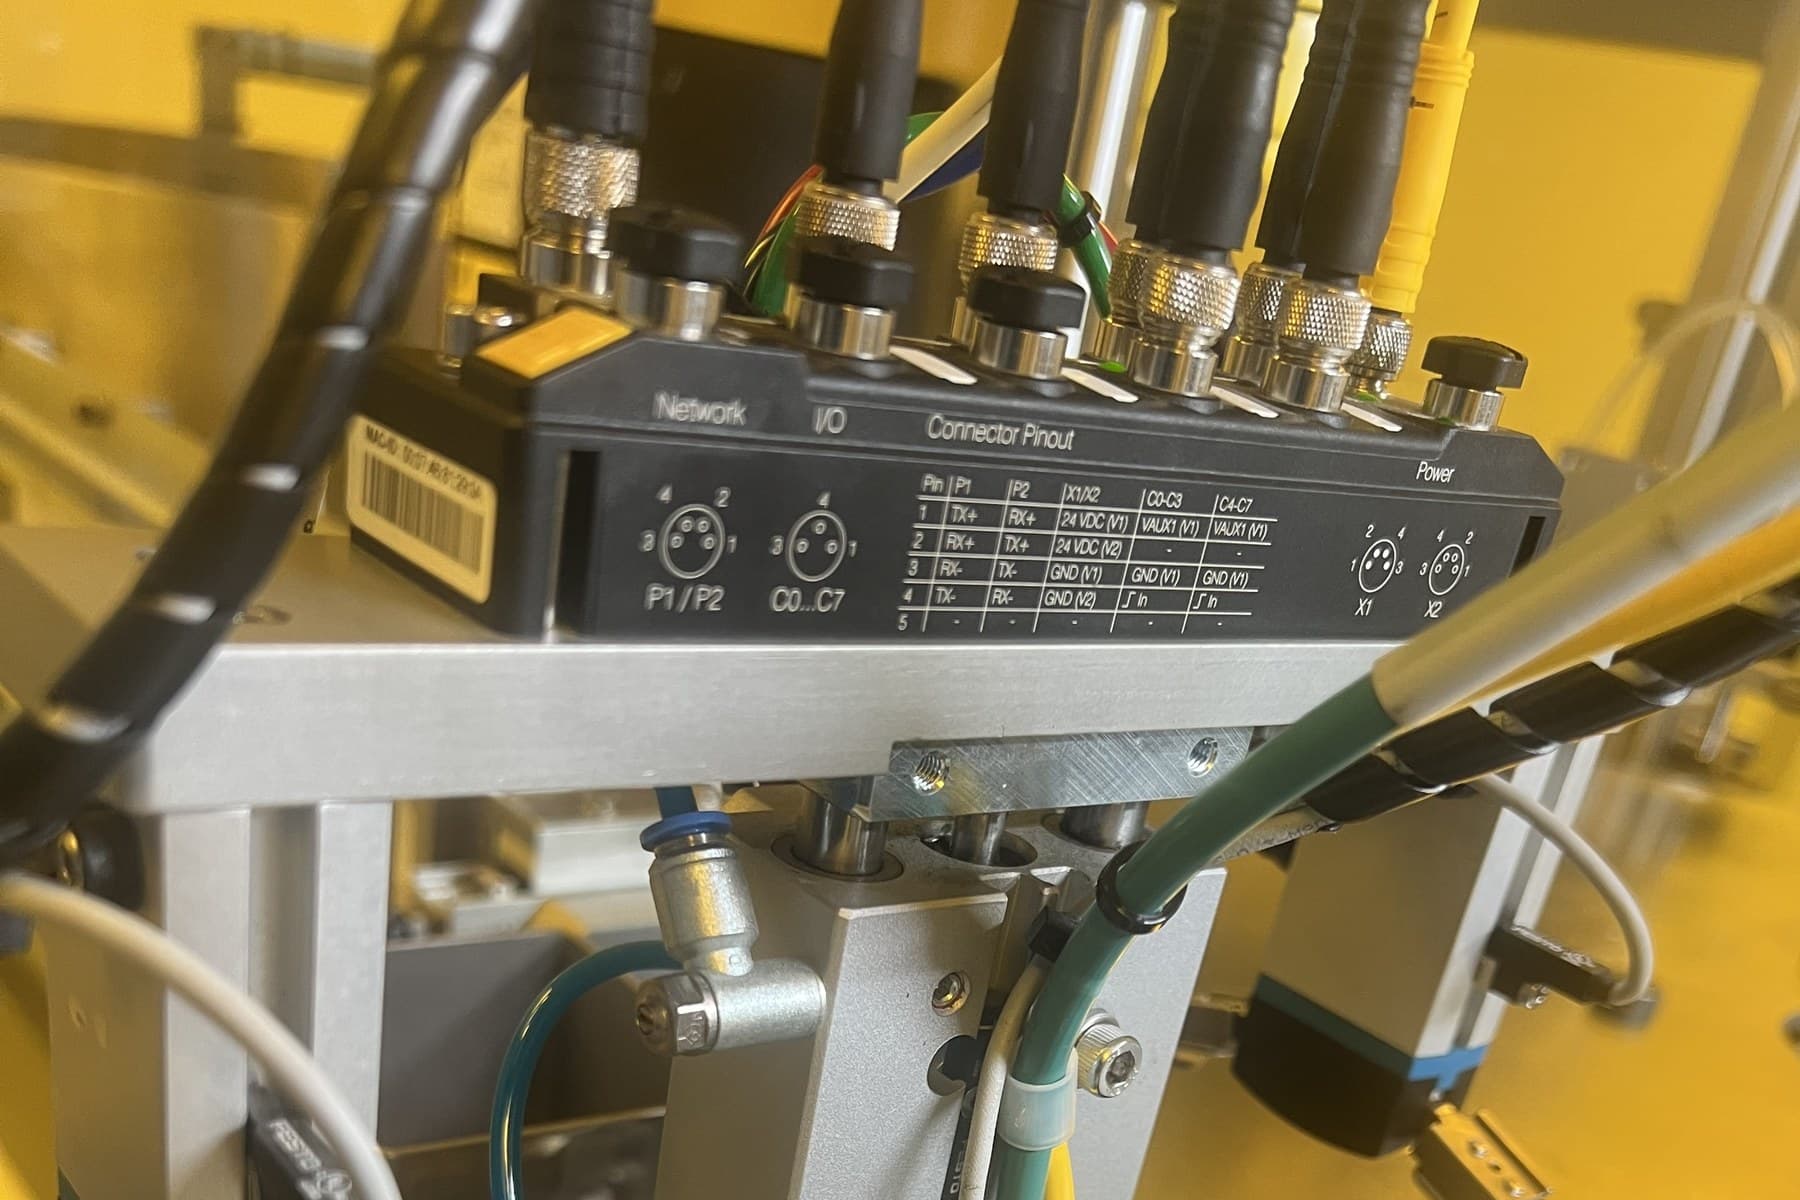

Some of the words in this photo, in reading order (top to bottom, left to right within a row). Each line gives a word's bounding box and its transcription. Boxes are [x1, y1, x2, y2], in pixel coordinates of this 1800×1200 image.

[652, 391, 748, 426] Network
[813, 406, 847, 434] I/O
[927, 413, 1019, 446] Connector
[1022, 422, 1075, 451] Pinout
[1416, 461, 1455, 483] Power
[656, 484, 672, 504] 4
[714, 486, 731, 508] 2
[816, 491, 831, 509] 4
[922, 473, 944, 493] Pin
[955, 476, 972, 495] P1
[1012, 480, 1031, 499] P2
[1066, 485, 1101, 504] X1/X2
[1147, 490, 1183, 509] C0-C3
[1219, 495, 1254, 513] C4-C7
[919, 504, 927, 520] 1
[952, 504, 978, 524] TX+
[1008, 509, 1037, 527] RX+
[1061, 512, 1076, 528] 24
[1079, 512, 1105, 529] VDC
[1106, 514, 1129, 533] (V1)
[1142, 517, 1176, 534] VAUX1
[1178, 520, 1200, 538] (V1)
[1214, 520, 1246, 537] VAUX1
[1247, 523, 1268, 541] (V1)
[1365, 524, 1375, 538] 2
[1398, 526, 1407, 540] 4
[1437, 529, 1444, 542] 4
[1465, 531, 1474, 545] 2
[727, 534, 738, 553] 1
[769, 535, 784, 555] 3
[848, 539, 857, 557] 1
[912, 530, 924, 550] 2
[946, 533, 975, 551] RX+
[1005, 535, 1030, 553] TX+
[1055, 538, 1070, 554] 24
[1073, 538, 1099, 555] VDC
[1100, 540, 1123, 559] (V2)
[1351, 558, 1357, 571] 1
[1395, 560, 1404, 575] 3
[1420, 562, 1428, 576] 3
[1464, 564, 1470, 577] 1
[908, 560, 919, 577] 3
[940, 560, 963, 577] RX-
[999, 563, 1018, 579] TX-
[1050, 564, 1079, 581] GND
[1081, 566, 1103, 585] (V1)
[1131, 567, 1159, 583] GND
[1159, 568, 1180, 587] (V1)
[1202, 570, 1228, 586] GND
[1229, 571, 1249, 590] (V1)
[903, 586, 914, 604] 4
[935, 586, 956, 605] TX-
[992, 589, 1014, 606] RX-
[1044, 590, 1073, 607] GND
[1074, 591, 1097, 611] (V2)
[1137, 593, 1149, 608] In
[1207, 594, 1218, 609] In
[1355, 597, 1373, 616] X1
[1424, 599, 1443, 618] X2
[898, 612, 909, 631] 5
